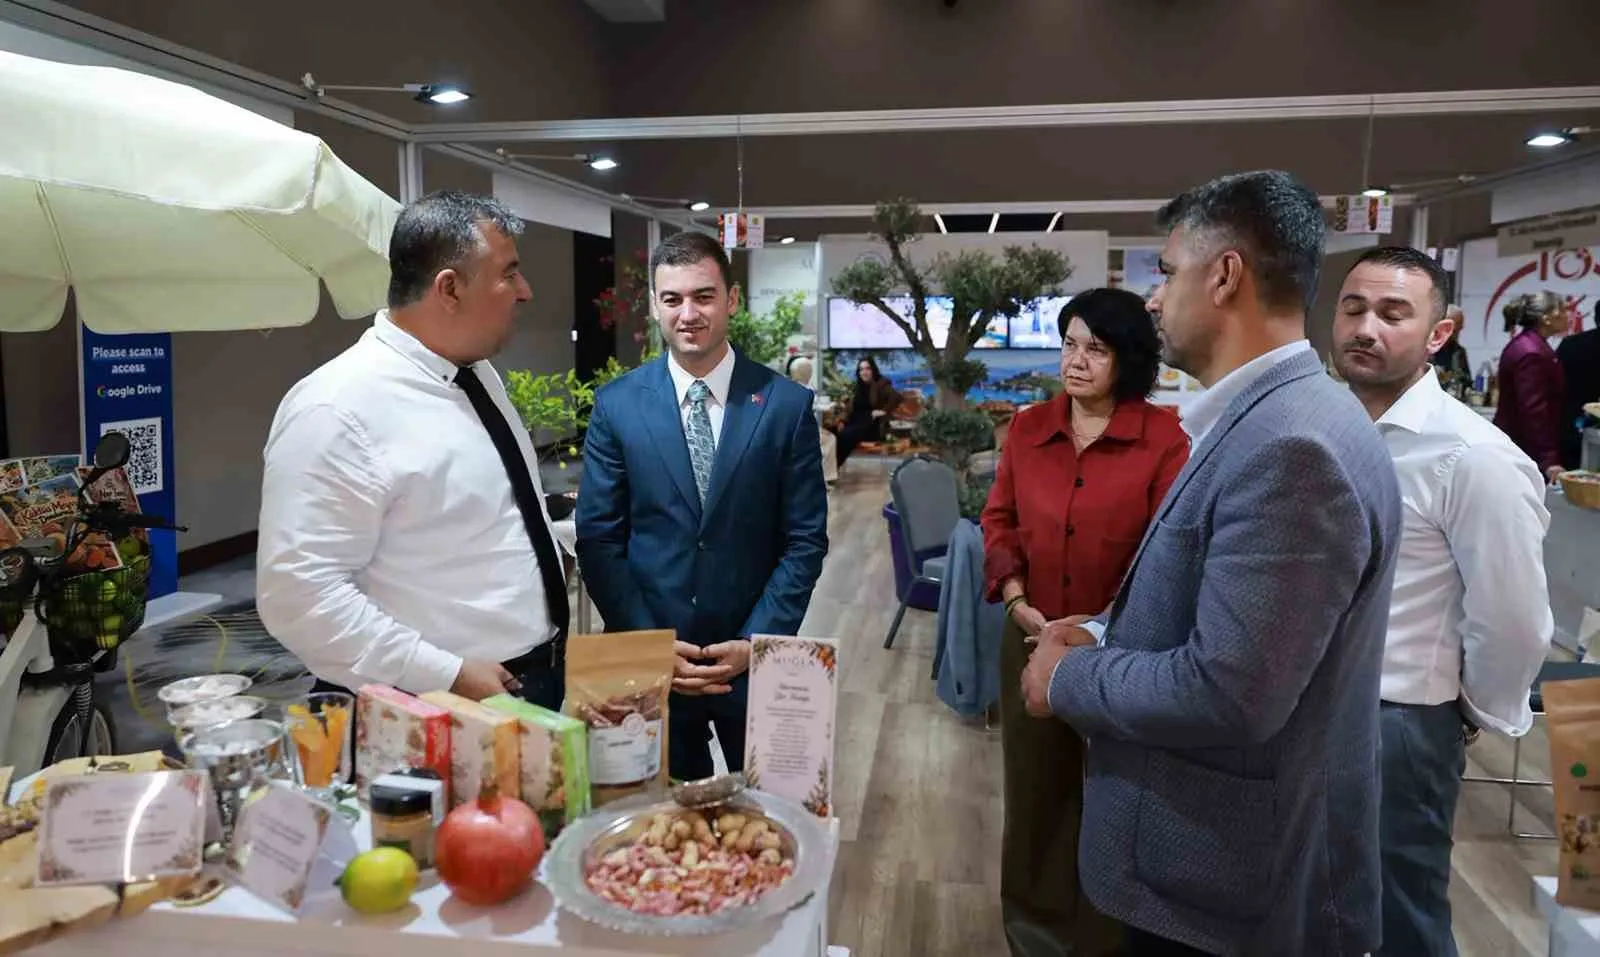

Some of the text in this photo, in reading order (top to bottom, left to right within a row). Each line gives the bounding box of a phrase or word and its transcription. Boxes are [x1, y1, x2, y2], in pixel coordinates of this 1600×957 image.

[92, 346, 165, 358] Please scan to
[111, 363, 146, 374] access
[97, 384, 163, 398] Google Drive
